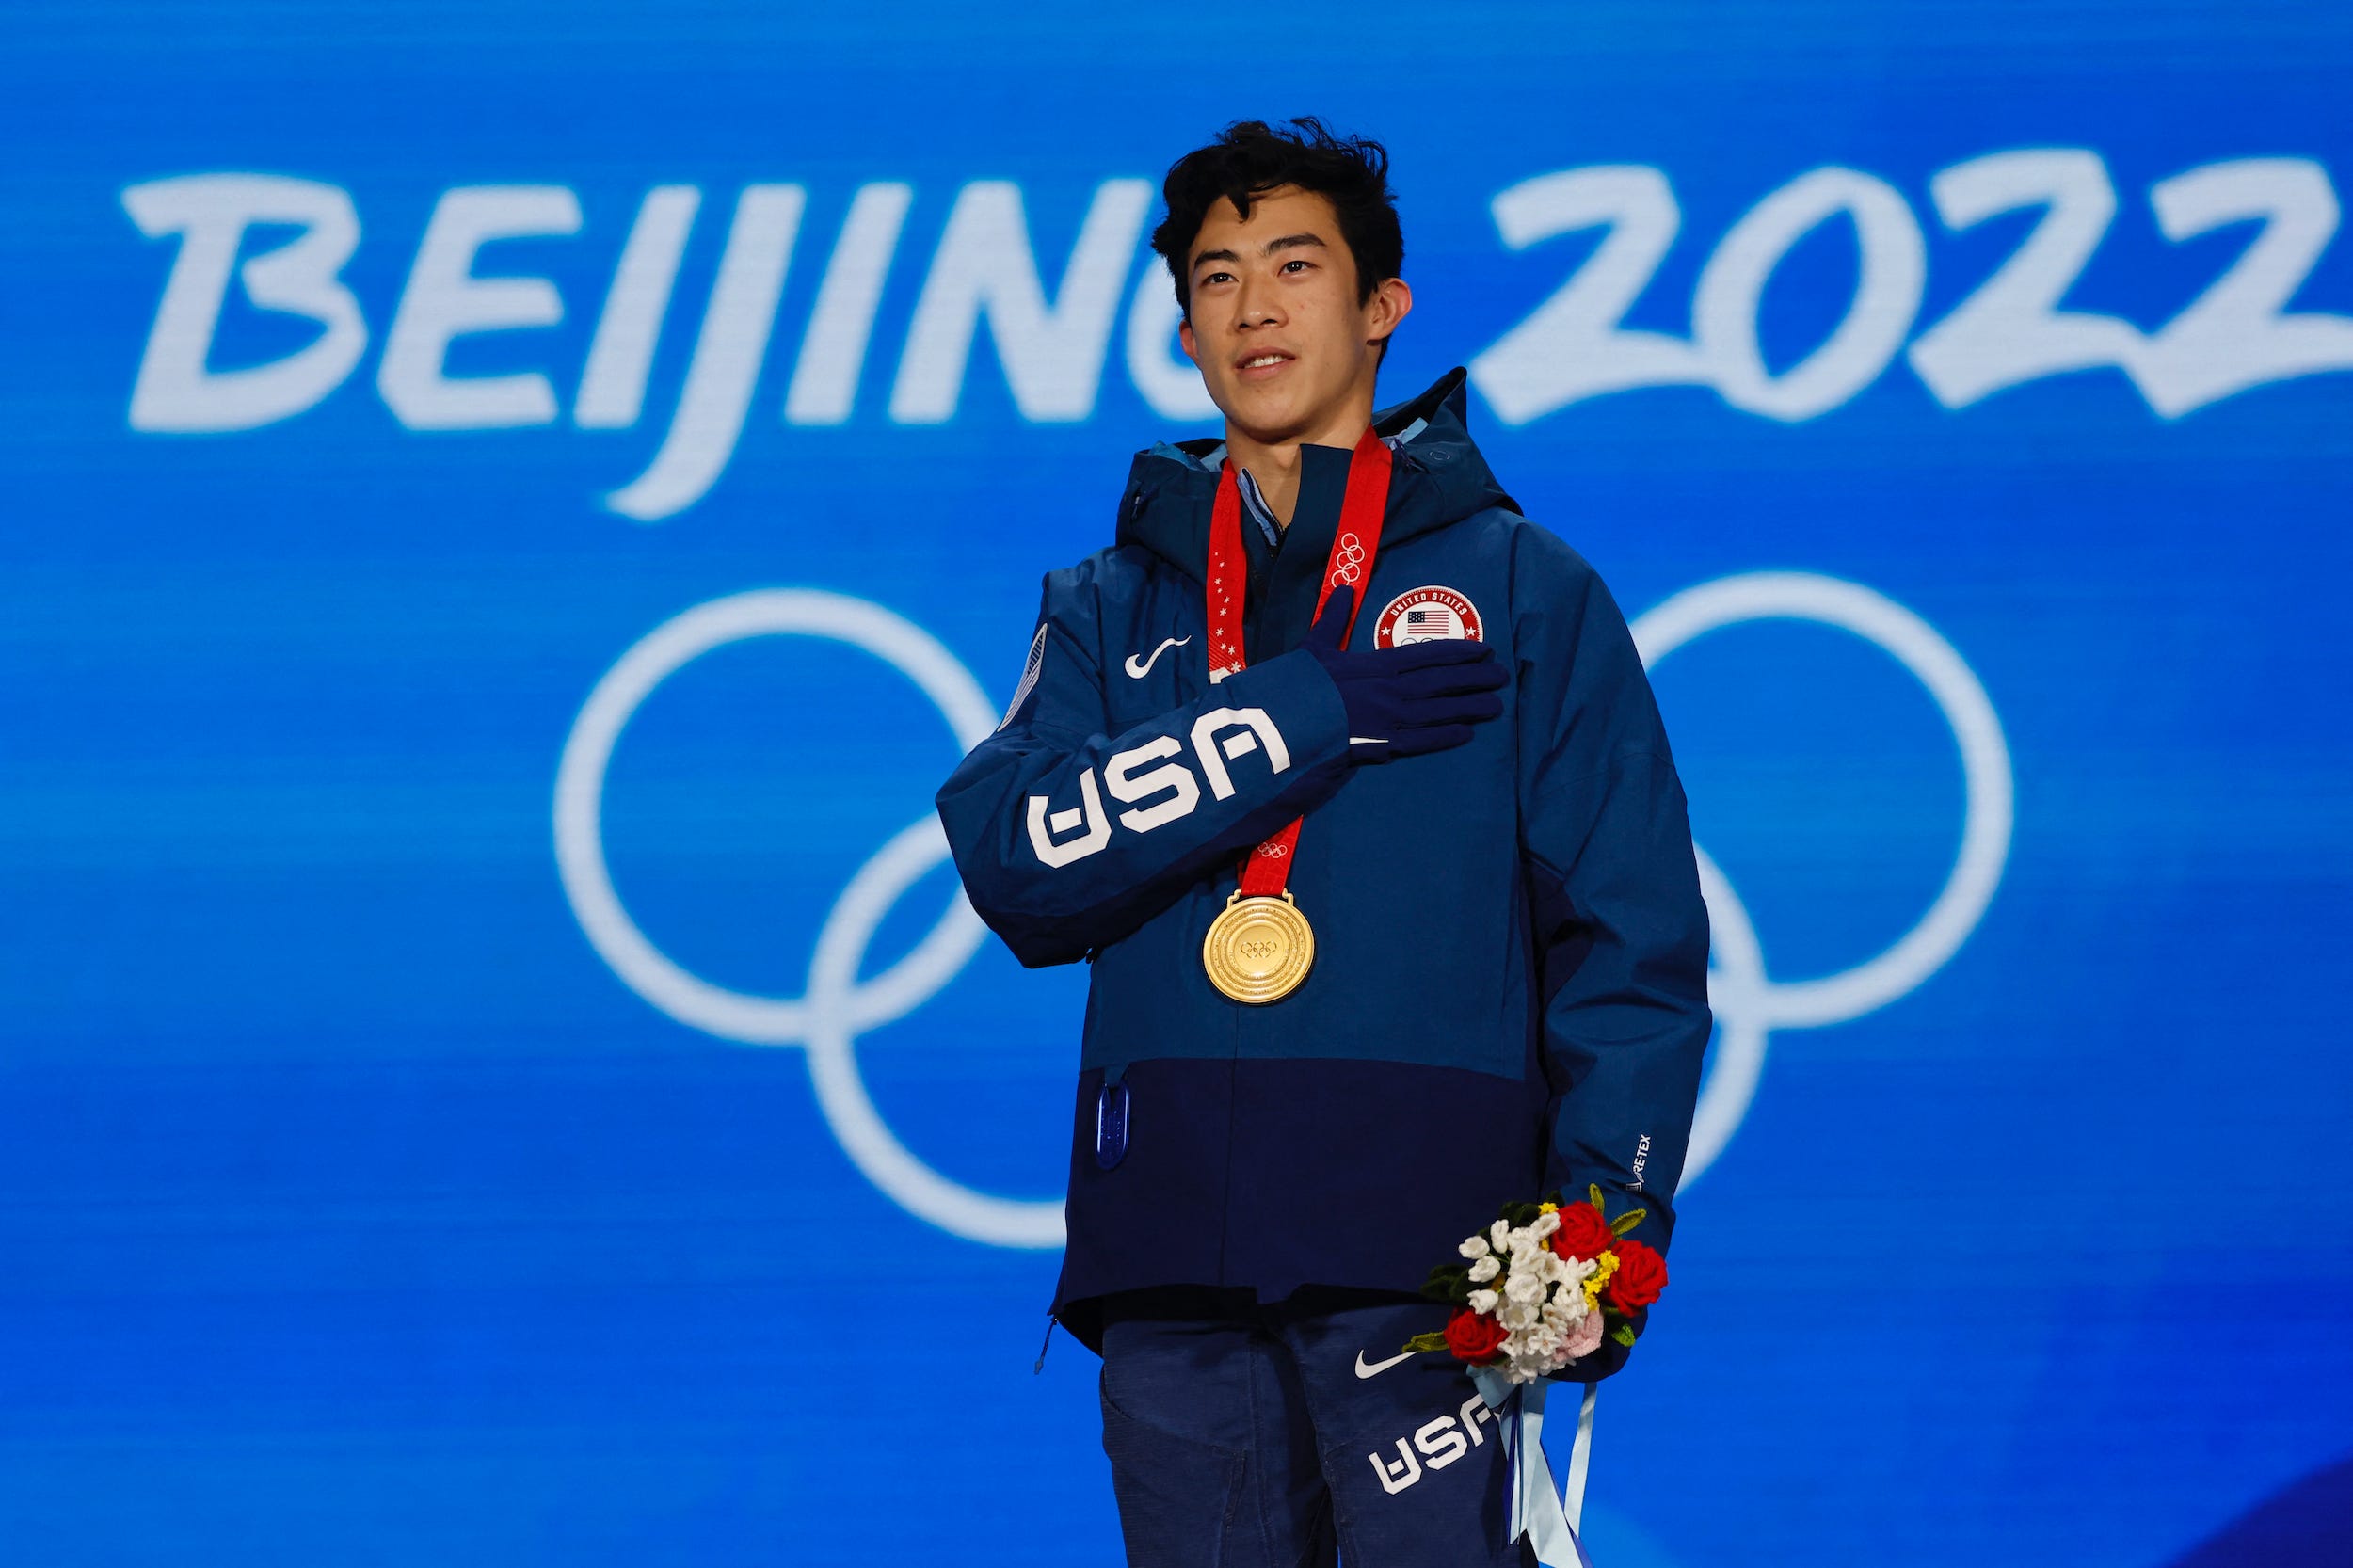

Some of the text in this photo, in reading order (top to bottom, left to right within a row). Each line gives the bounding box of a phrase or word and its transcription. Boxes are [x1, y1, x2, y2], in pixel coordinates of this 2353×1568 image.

[1469, 148, 2353, 424] 2022
[1390, 592, 1468, 616] UNITED STATES
[1027, 707, 1290, 869] USA
